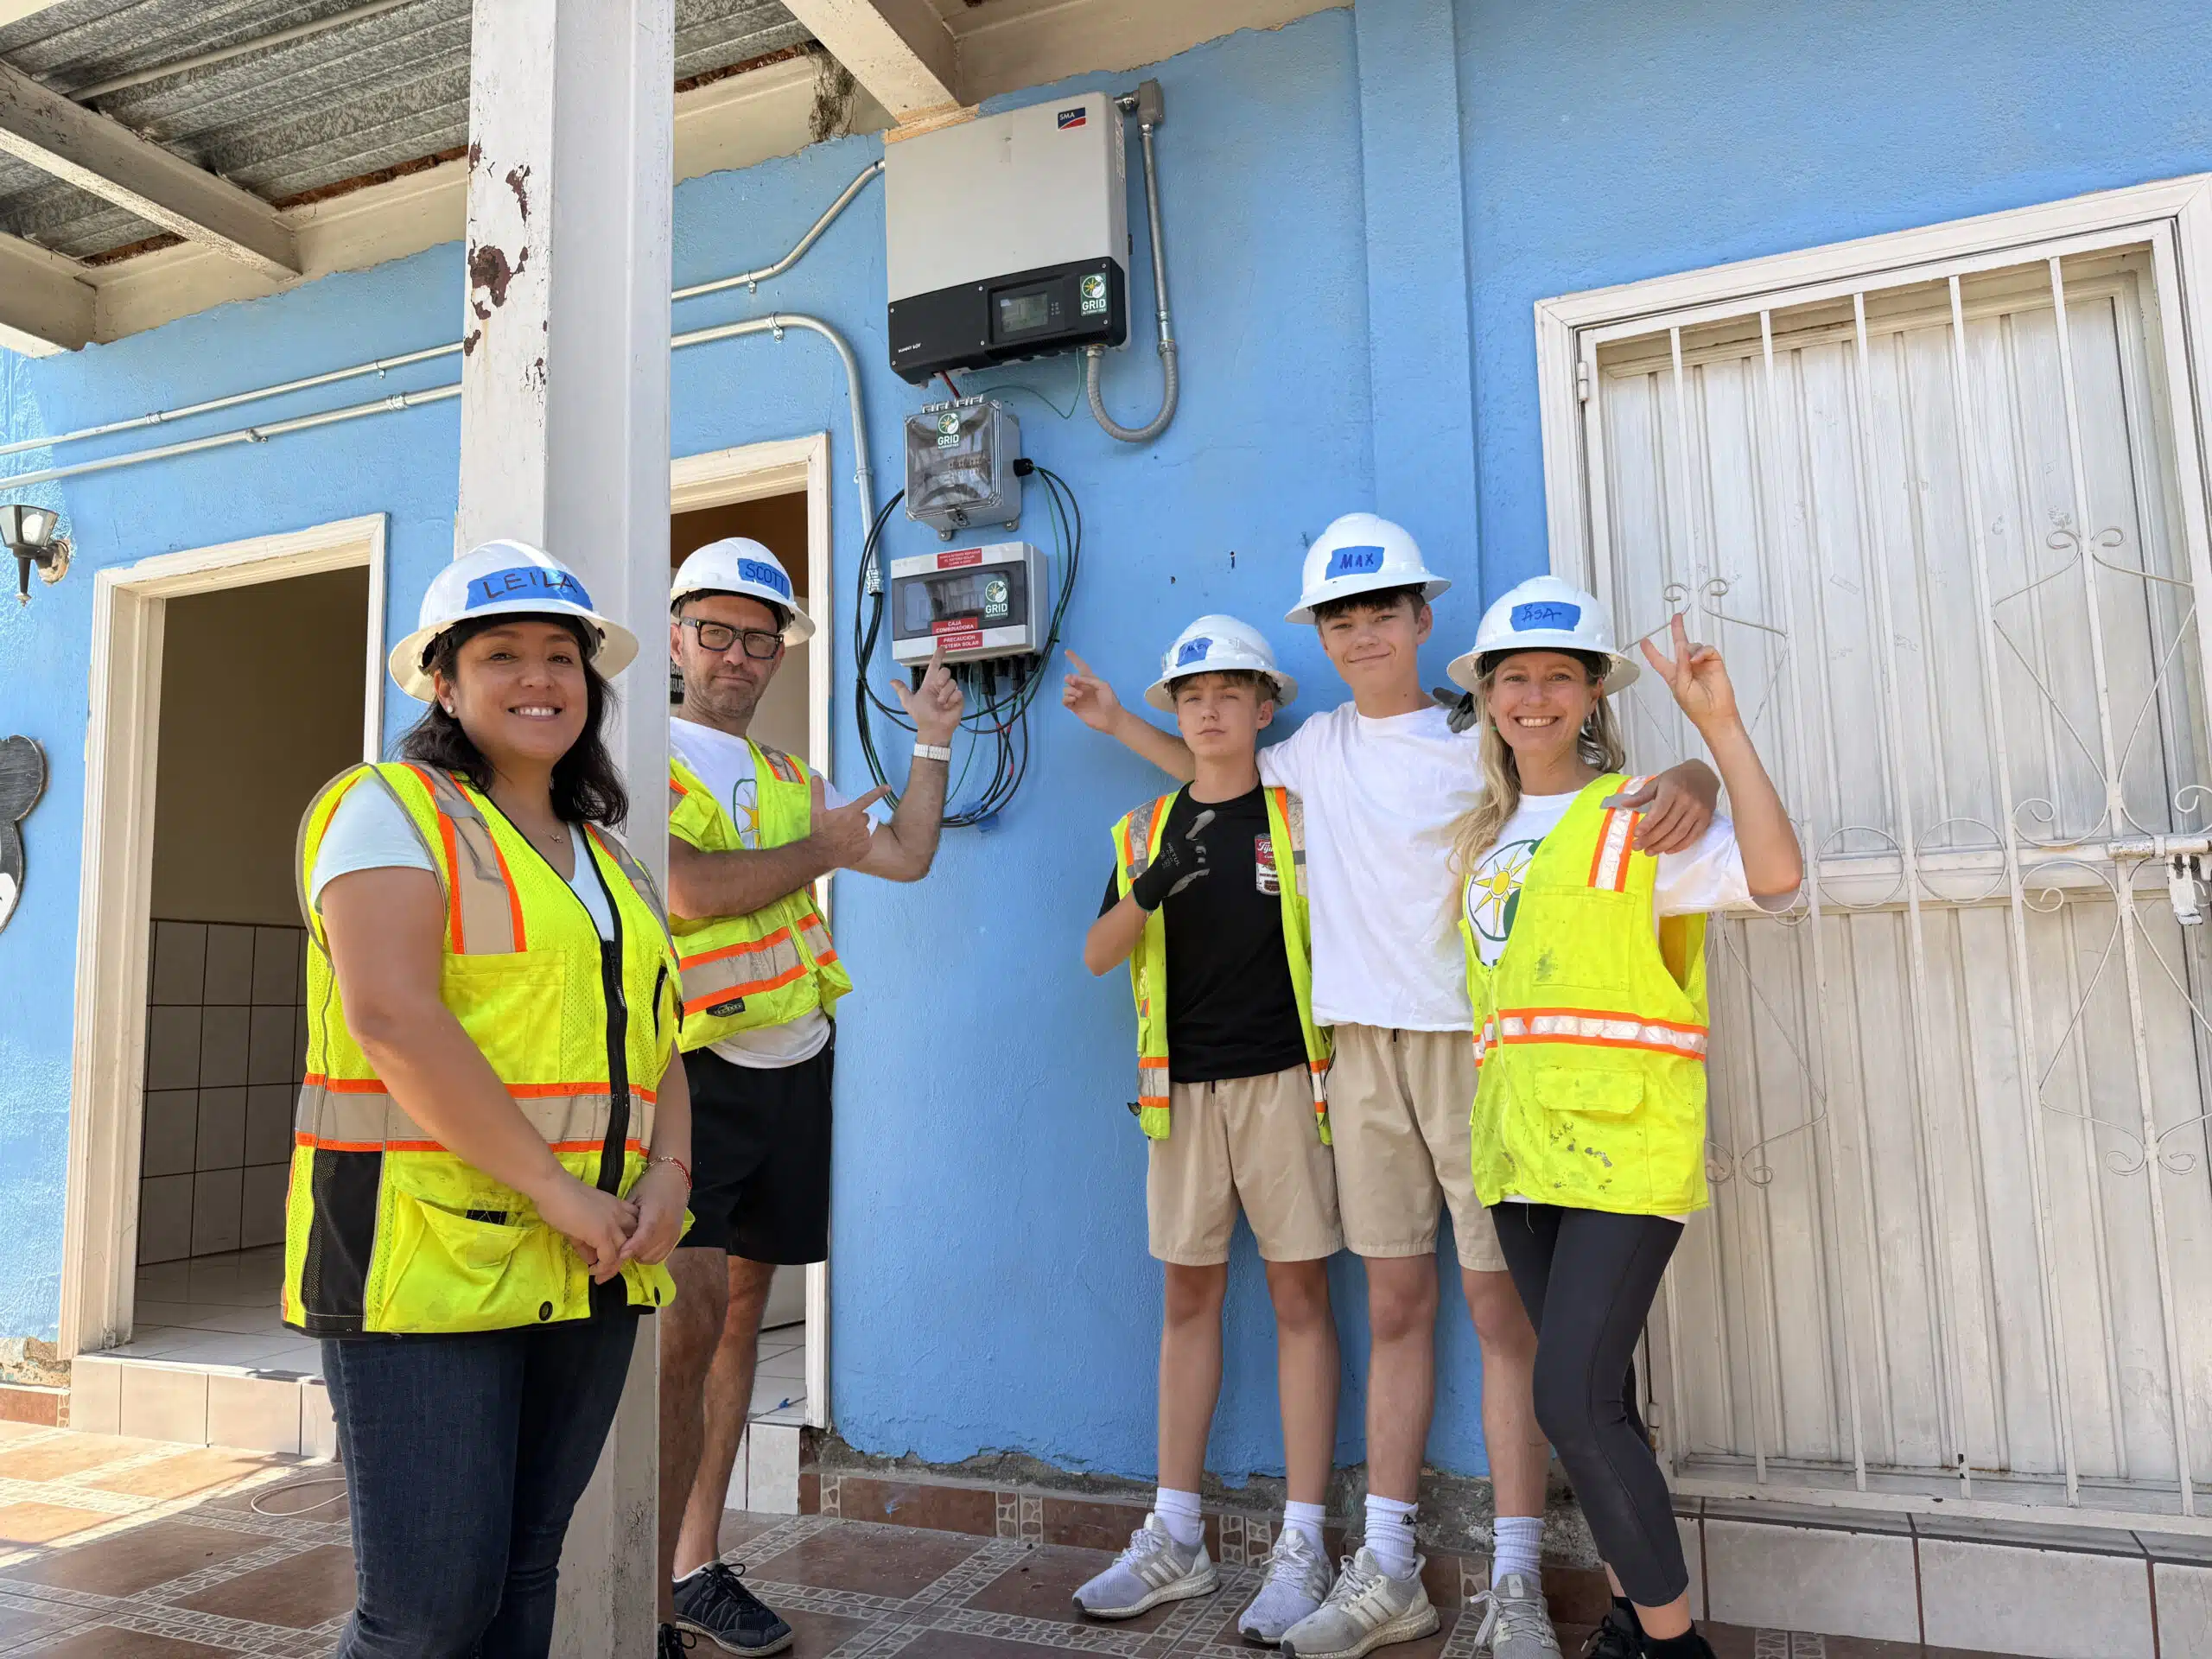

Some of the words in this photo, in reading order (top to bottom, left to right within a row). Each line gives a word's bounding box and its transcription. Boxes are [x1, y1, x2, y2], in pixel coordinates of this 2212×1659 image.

[1059, 111, 1075, 121] SMA
[1082, 298, 1107, 311] GRID
[938, 434, 959, 446] GRID
[1339, 553, 1374, 570] MAX
[482, 570, 578, 599] LEILA
[745, 563, 785, 594] SCOTT
[985, 603, 1008, 614] GRID
[936, 624, 975, 633] COMBINADORA
